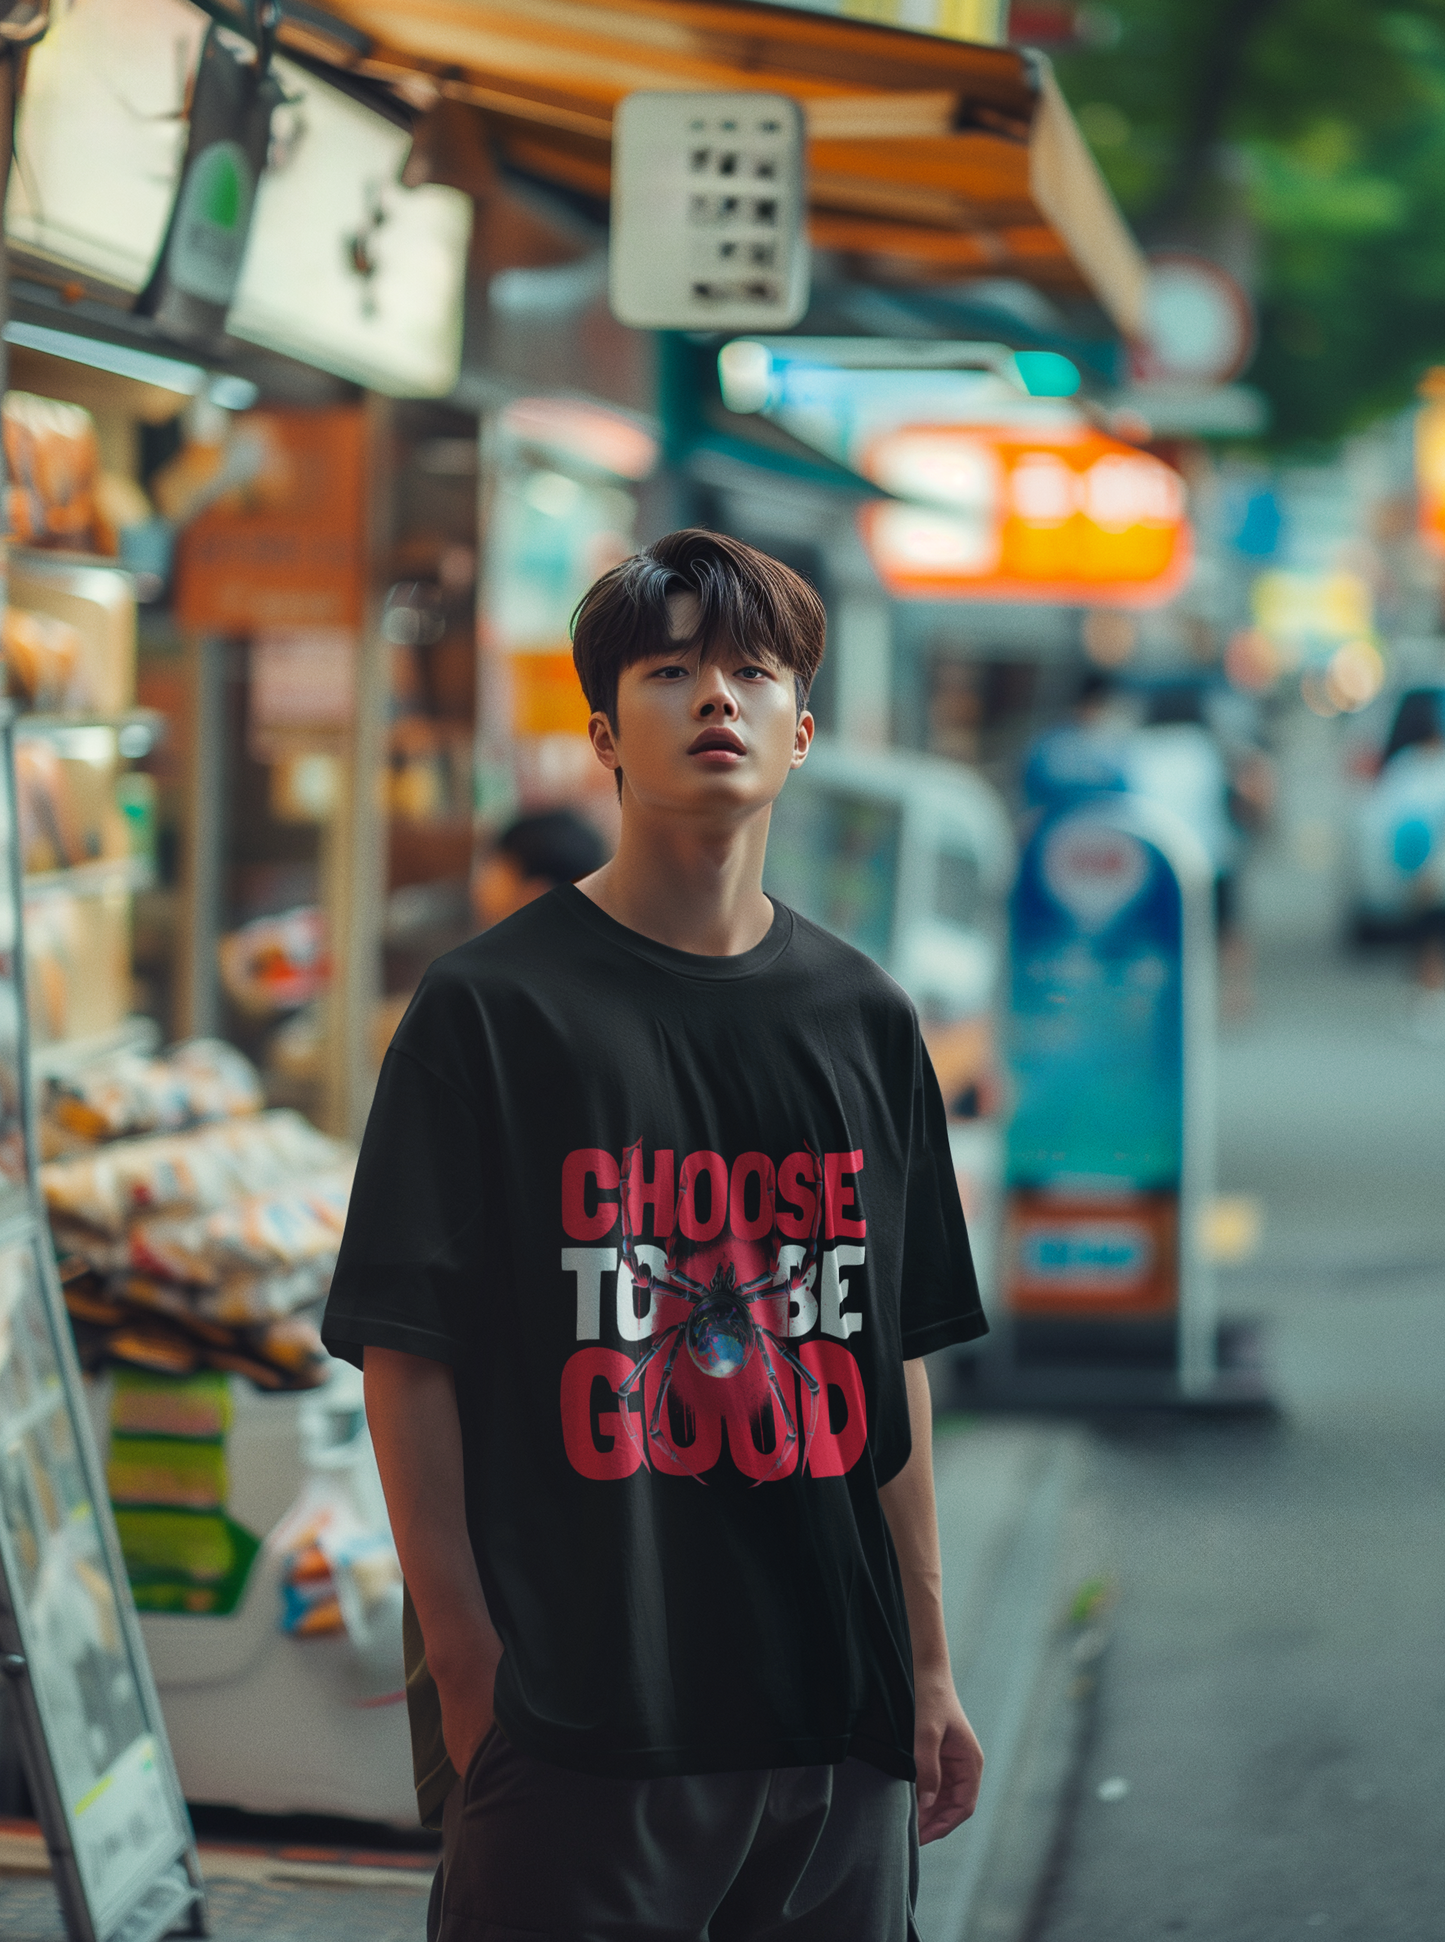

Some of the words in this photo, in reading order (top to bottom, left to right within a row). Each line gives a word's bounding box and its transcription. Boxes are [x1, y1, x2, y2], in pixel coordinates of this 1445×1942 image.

[561, 1147, 867, 1241] CHOOSE
[561, 1244, 669, 1342] TO
[773, 1244, 866, 1340] BE
[560, 1340, 867, 1481] GOOD
